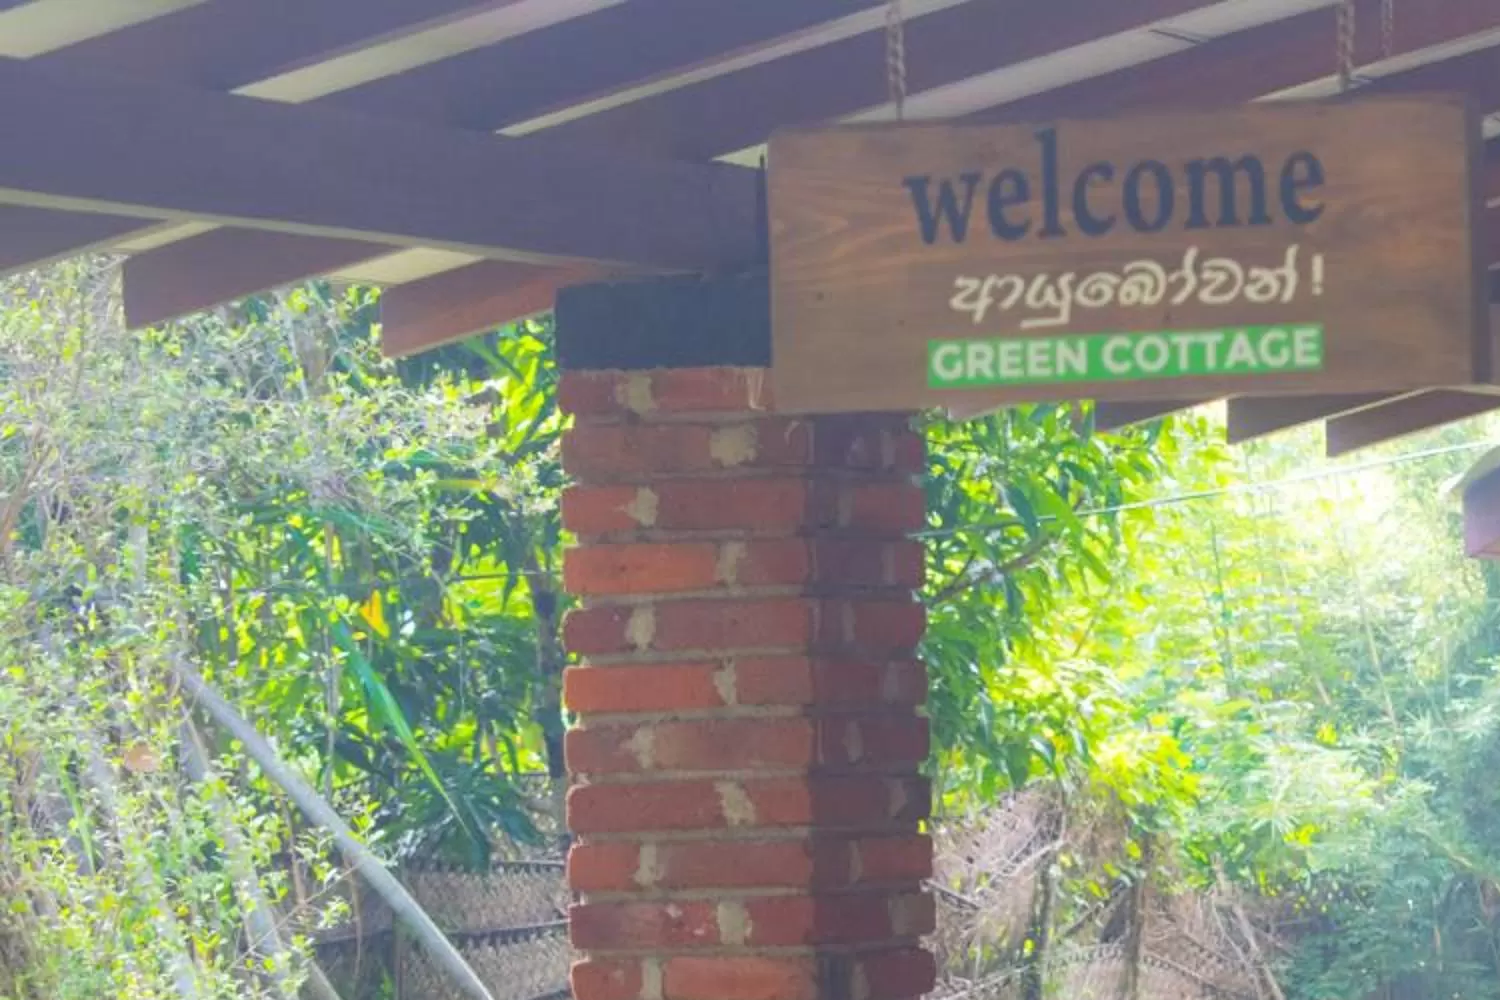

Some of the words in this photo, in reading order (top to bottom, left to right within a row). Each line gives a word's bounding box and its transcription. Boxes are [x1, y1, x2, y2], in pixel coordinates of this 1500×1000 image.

[903, 127, 1325, 246] welcome
[931, 339, 1088, 381] GREEN
[1101, 327, 1320, 374] COTTAGE
